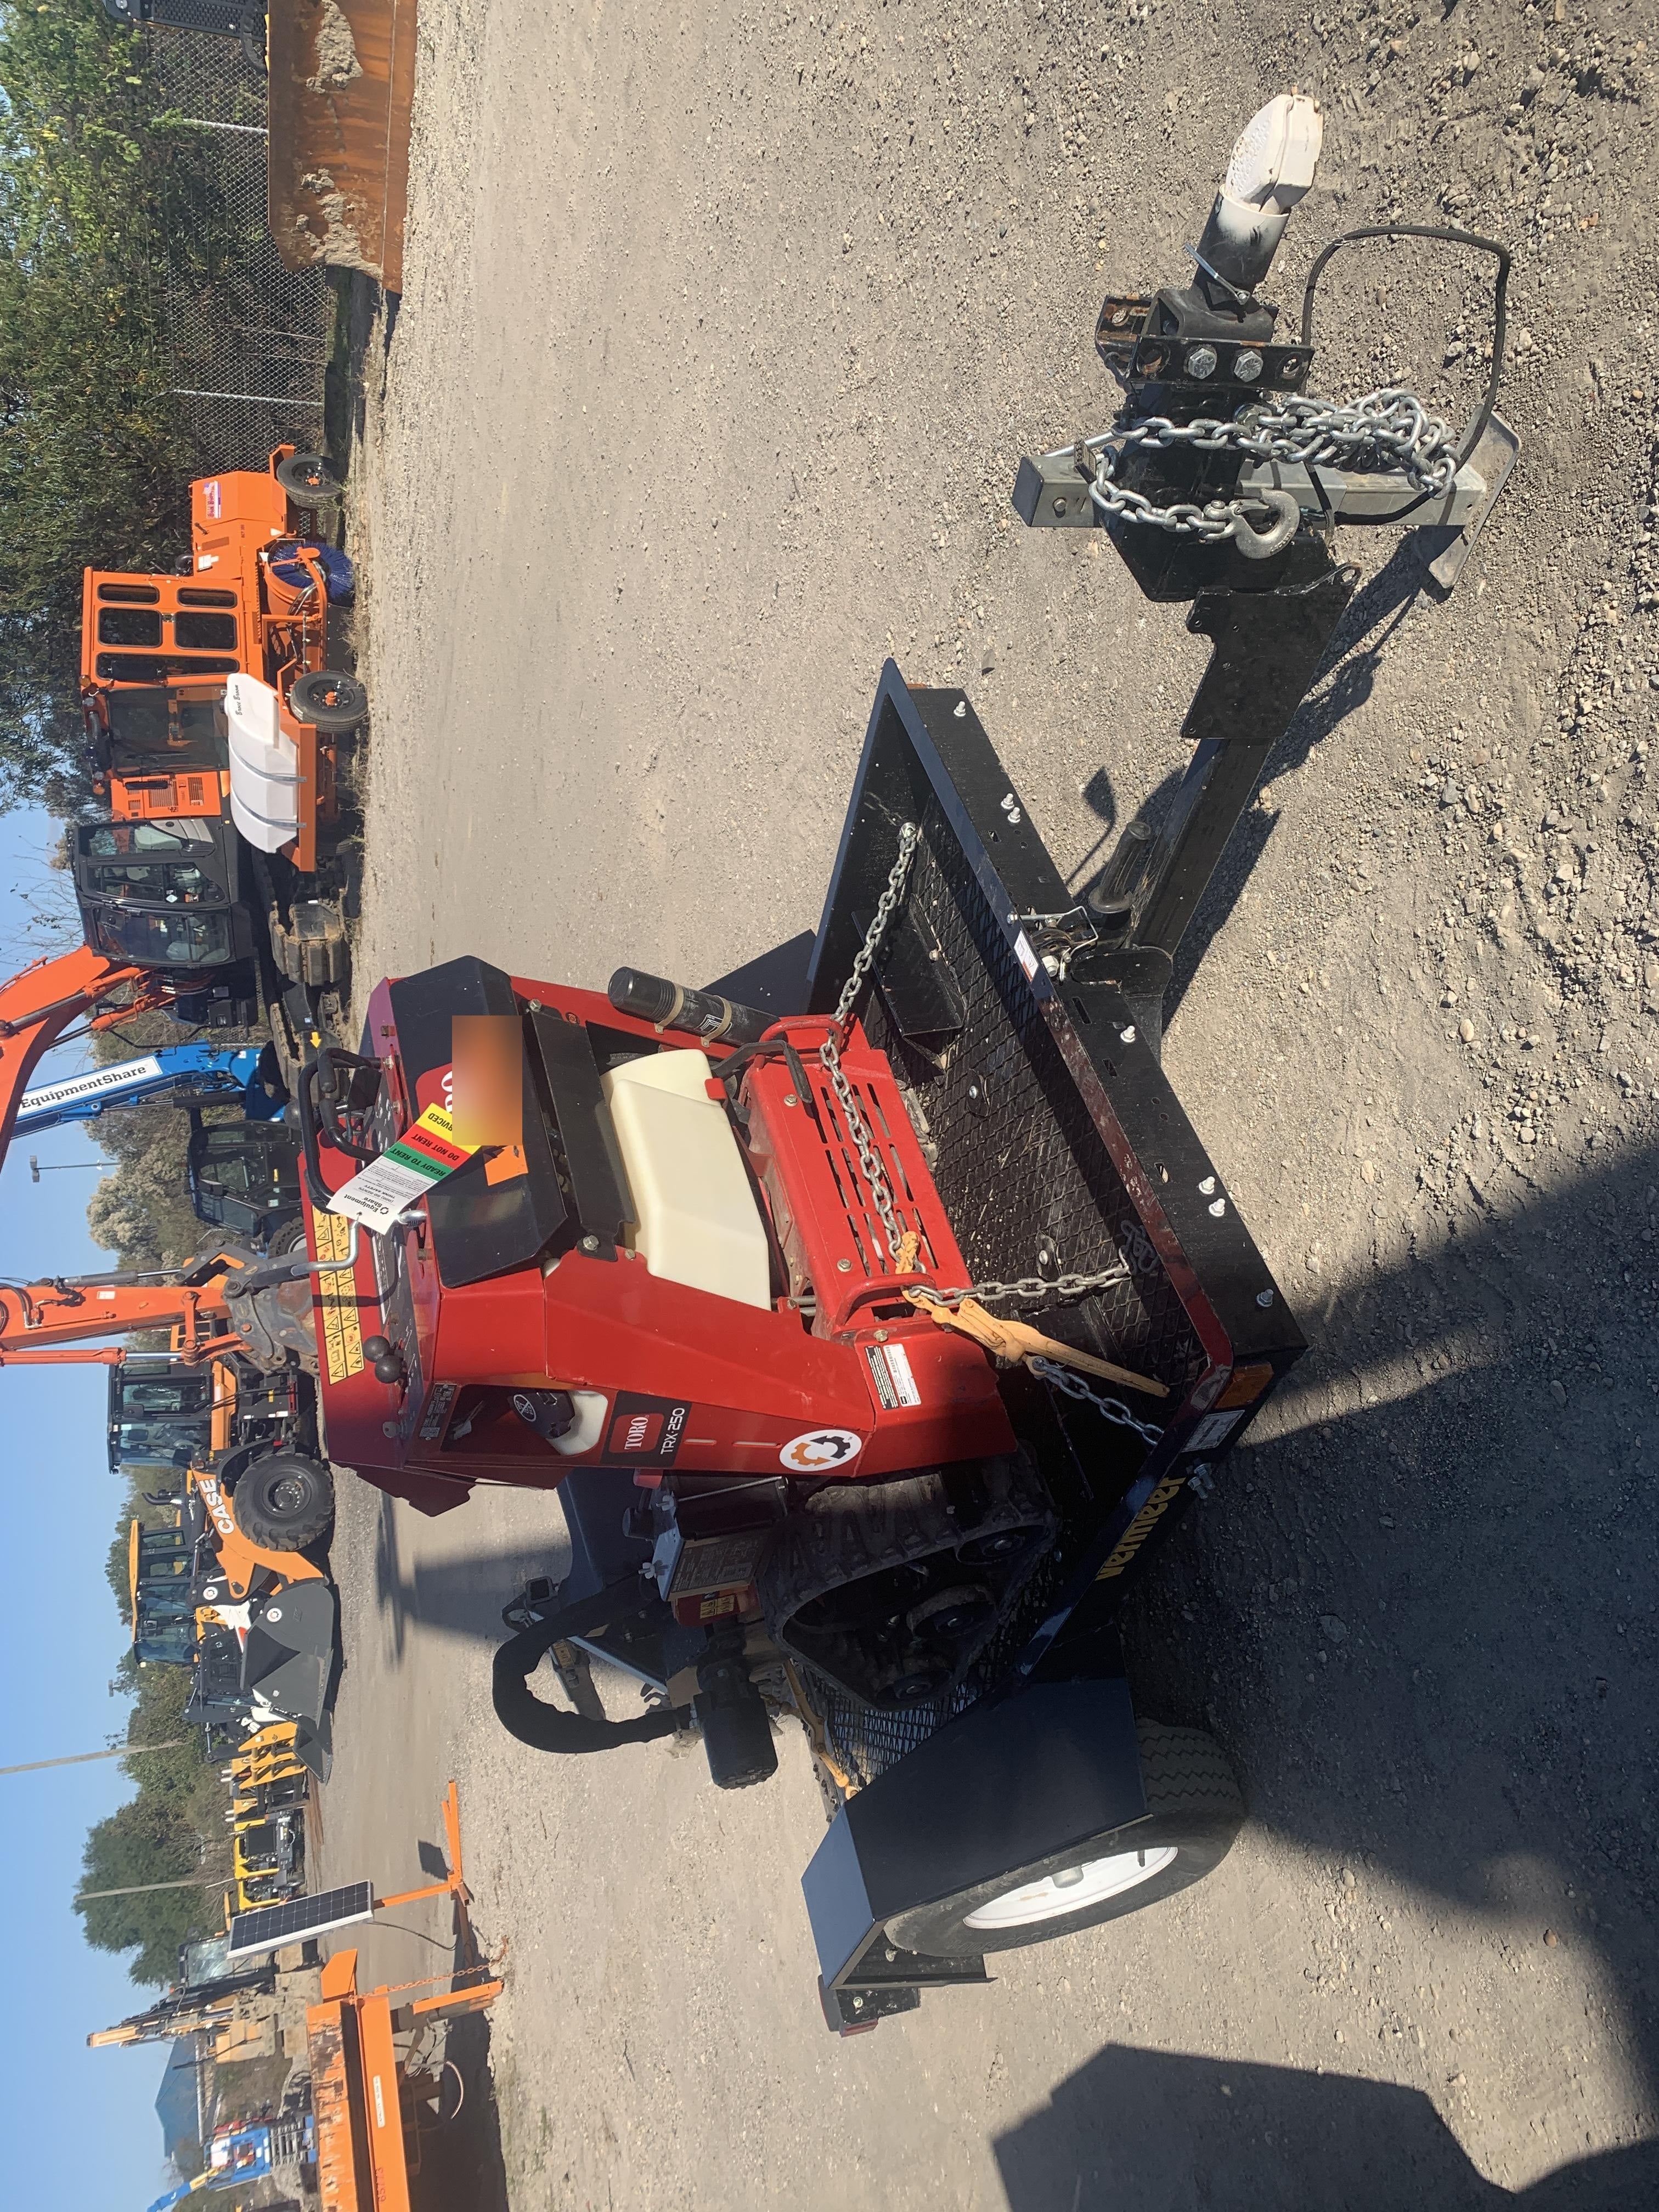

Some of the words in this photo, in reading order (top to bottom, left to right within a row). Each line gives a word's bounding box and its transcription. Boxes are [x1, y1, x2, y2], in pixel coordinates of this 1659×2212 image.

[21, 1066, 146, 1108] EquipmentShare
[427, 1113, 453, 1132] RVICED
[411, 1133, 432, 1146] RENT
[390, 1147, 411, 1159] RENT
[431, 1144, 449, 1155] NOT
[410, 1158, 422, 1166] TO
[448, 1152, 460, 1161] DO
[422, 1163, 447, 1177] READY
[343, 1194, 379, 1212] Equipment
[363, 1197, 382, 1207] Share
[624, 1417, 648, 1449] TORO
[198, 1479, 235, 1534] CASE
